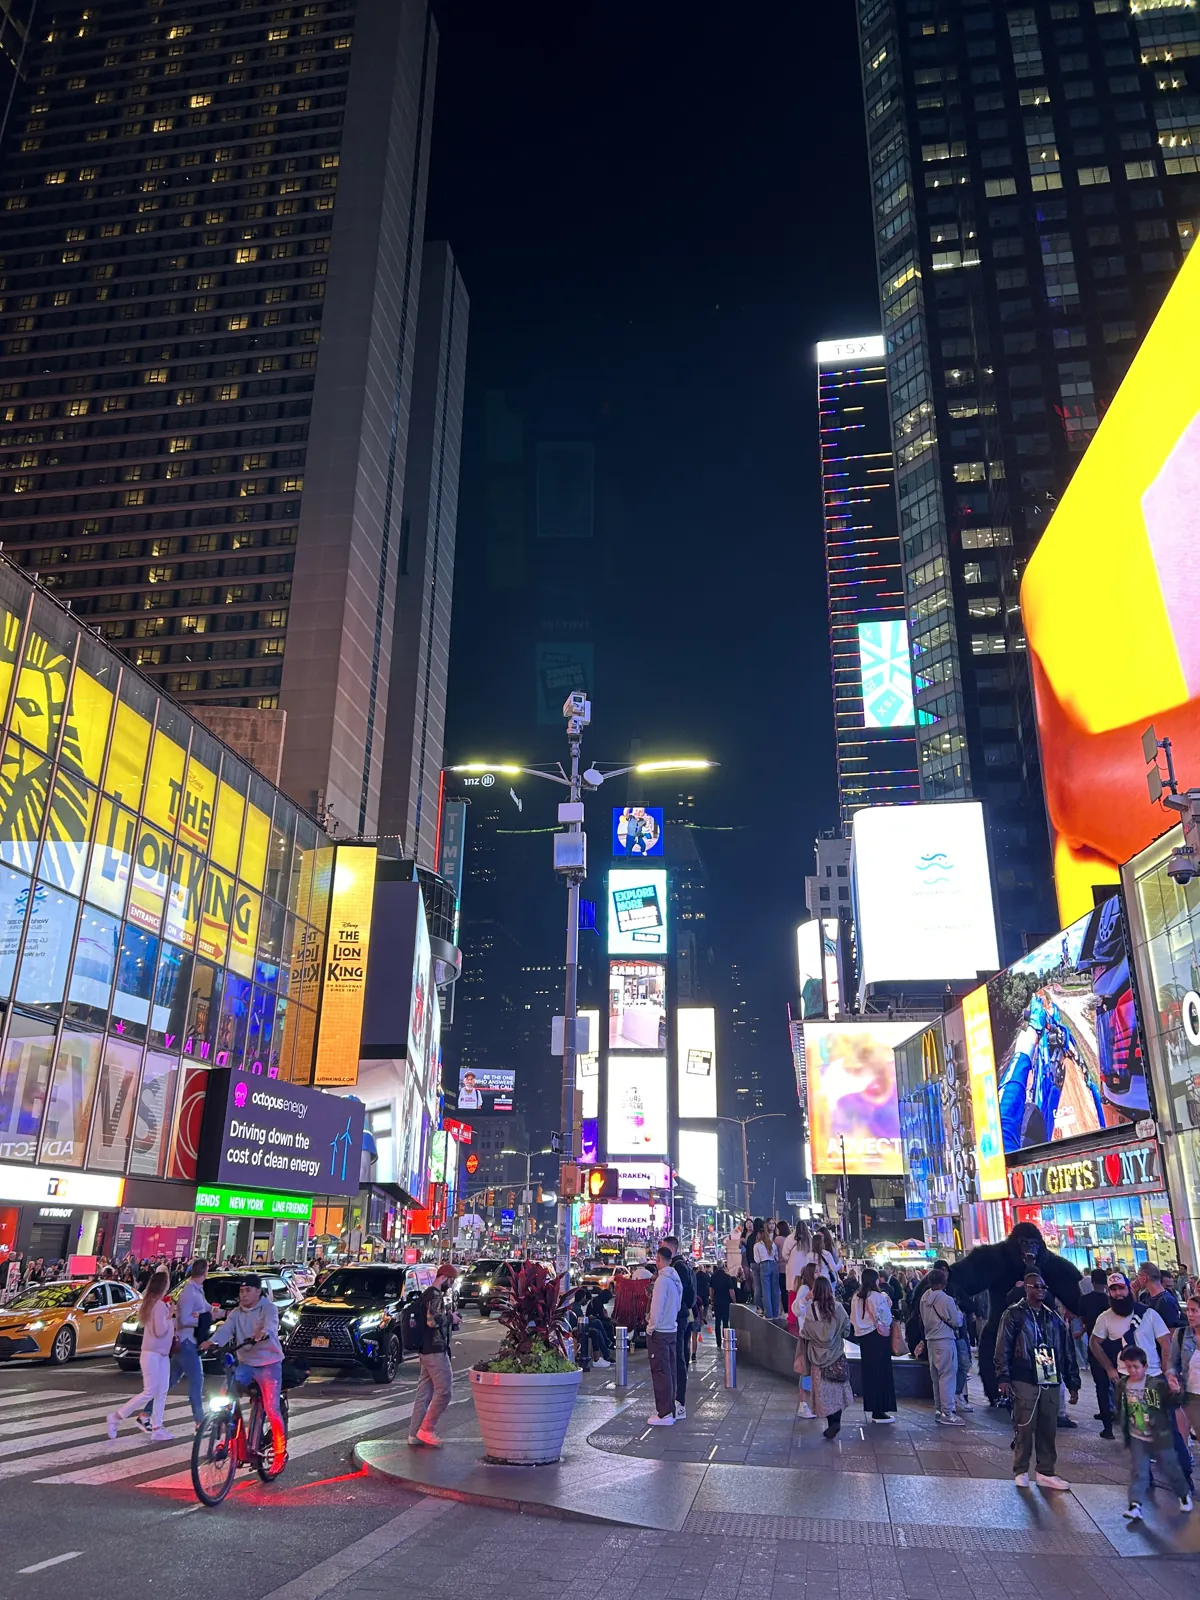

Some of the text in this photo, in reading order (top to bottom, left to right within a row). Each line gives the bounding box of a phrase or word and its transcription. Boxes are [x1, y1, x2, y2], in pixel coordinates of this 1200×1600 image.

[834, 343, 867, 354] TSX
[168, 777, 211, 837] THE
[186, 842, 251, 935] KING
[614, 886, 655, 902] EXPLORE
[616, 898, 644, 912] MORE
[130, 907, 160, 929] ENTRANCE
[168, 924, 177, 936] ON
[199, 939, 215, 953] STREET
[338, 931, 359, 941] THE
[333, 944, 361, 961] LION
[328, 963, 363, 981] KING
[230, 1120, 310, 1150] Driving down the
[227, 1148, 320, 1177] cost of clean energy
[1047, 1160, 1095, 1194] GIFTS
[228, 1196, 246, 1209] NEW
[246, 1198, 264, 1211] YORK
[271, 1201, 286, 1213] LINE
[285, 1202, 309, 1215] FRIENDS
